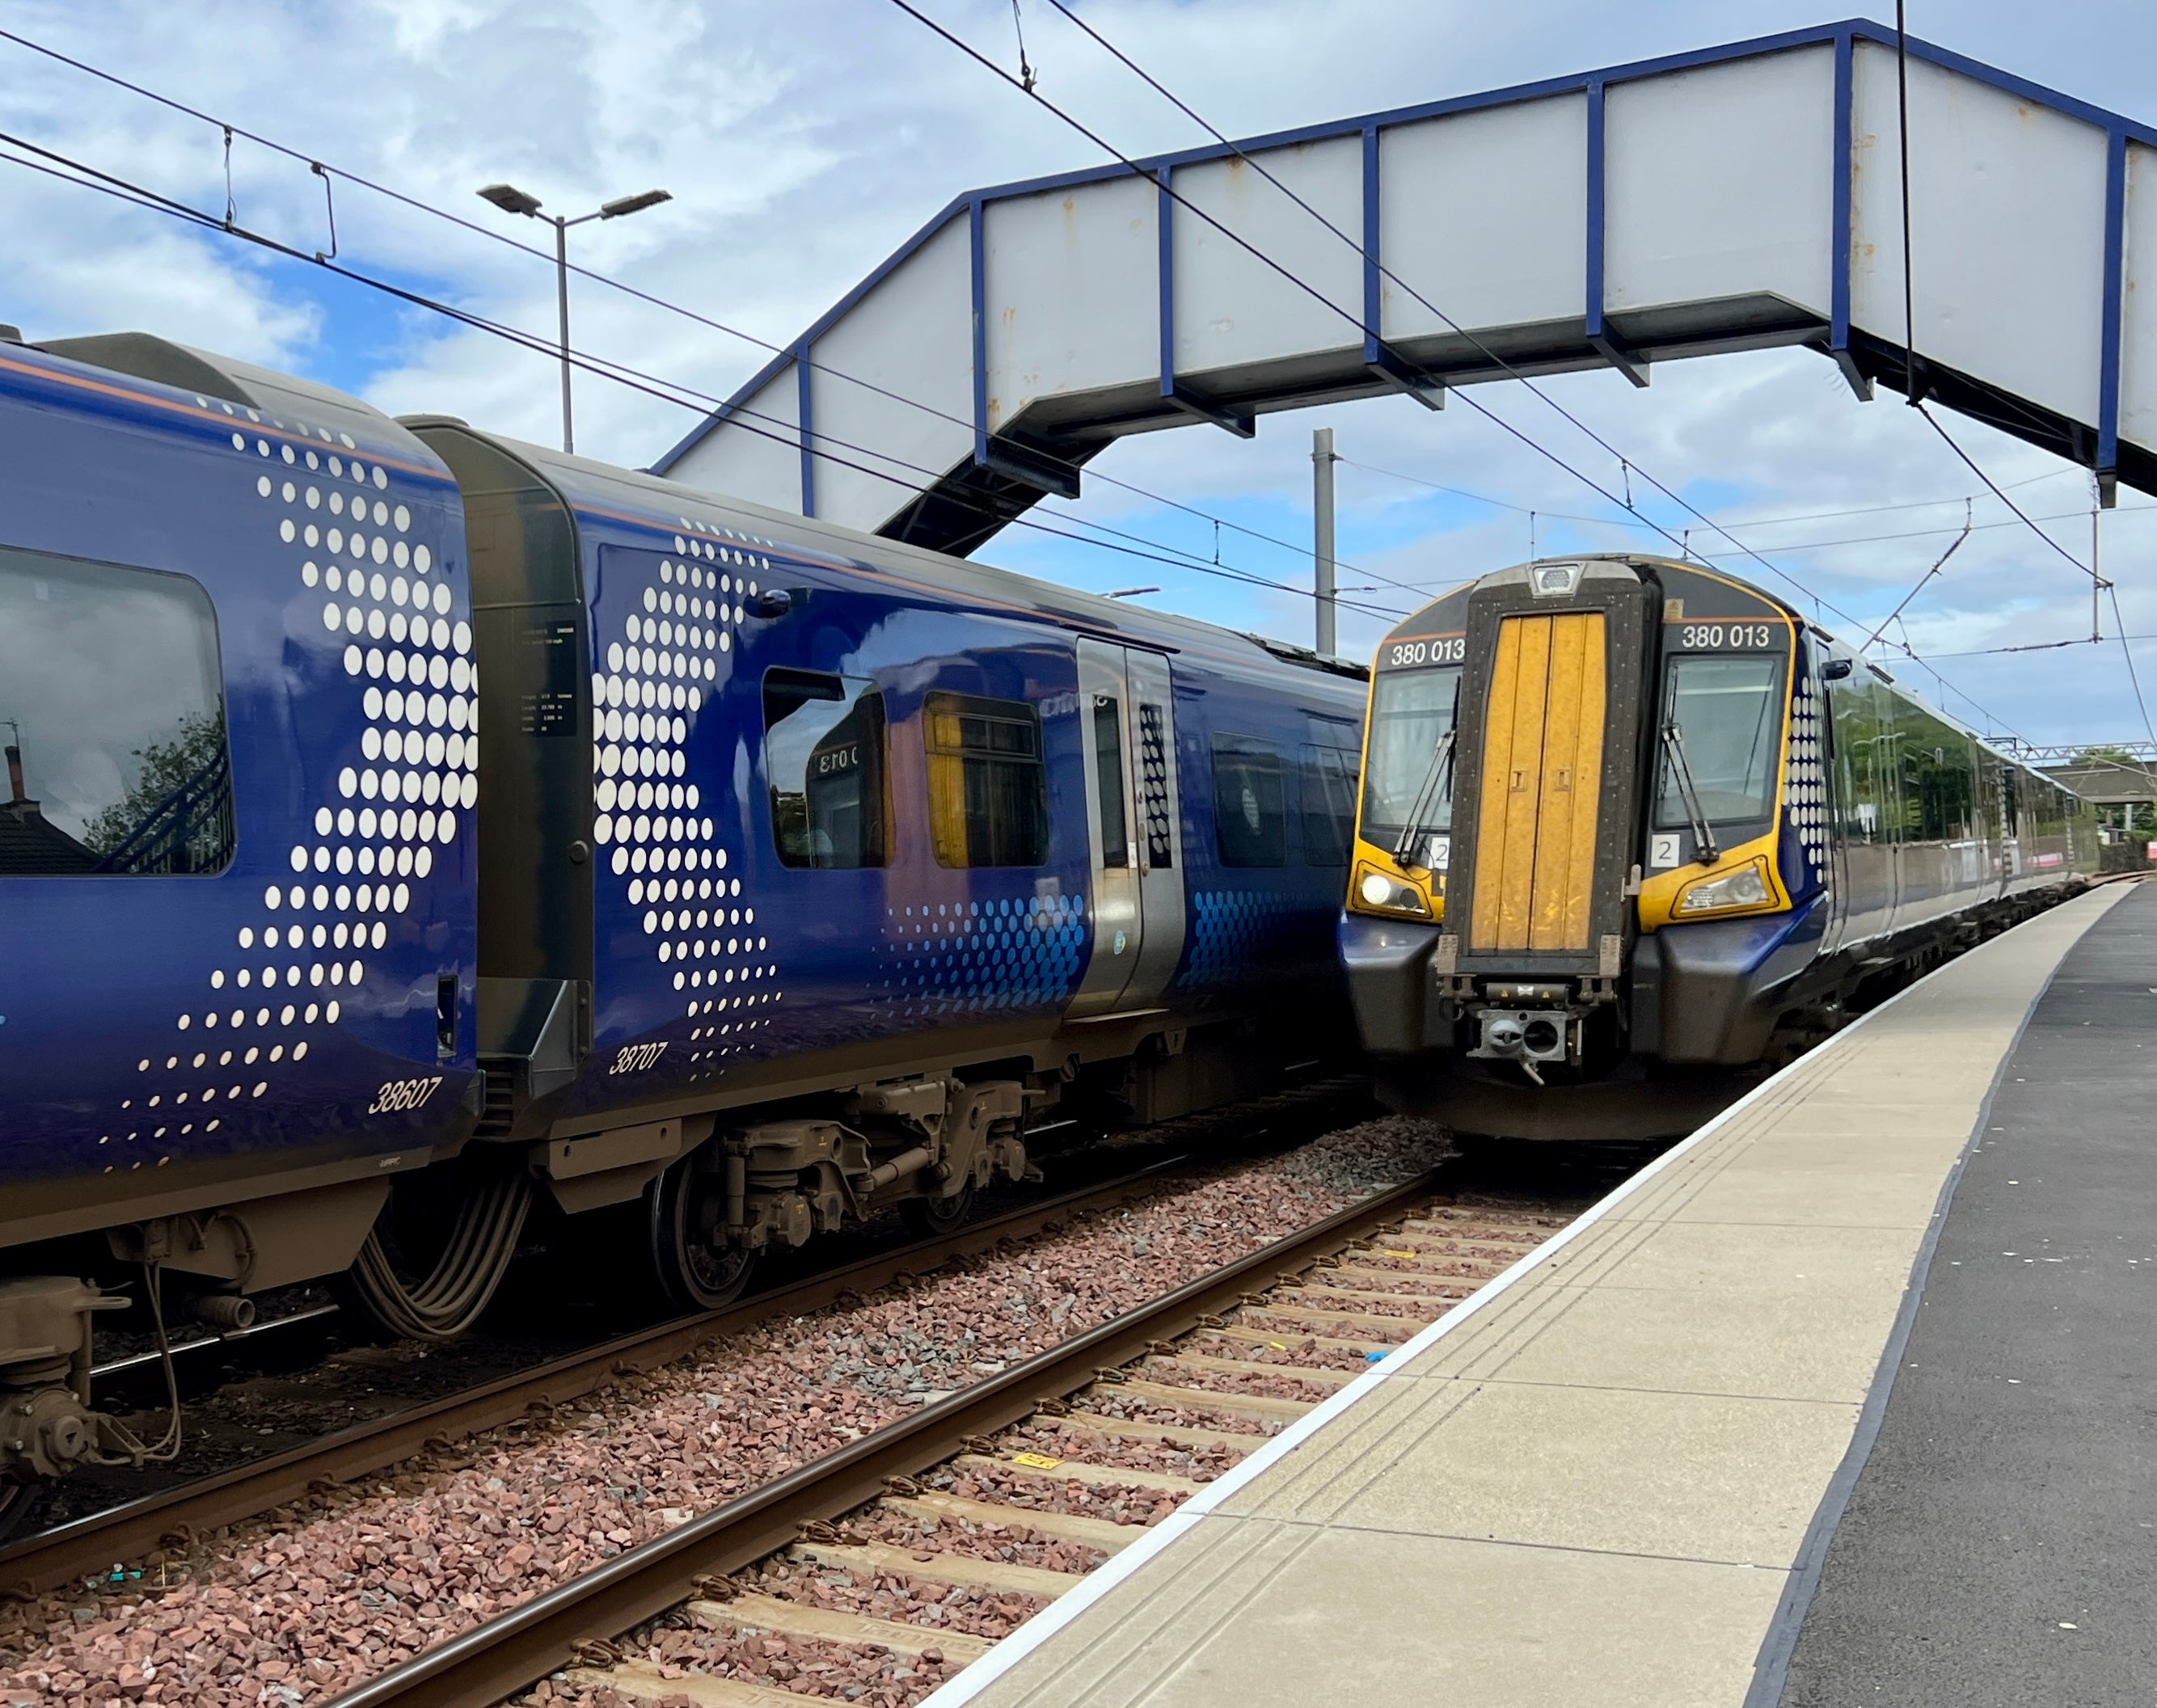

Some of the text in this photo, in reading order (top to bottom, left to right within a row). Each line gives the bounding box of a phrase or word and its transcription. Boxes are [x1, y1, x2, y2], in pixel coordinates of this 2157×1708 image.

[1682, 625, 1770, 647] 380 013
[1391, 639, 1466, 666] 380 013
[1435, 844, 1448, 862] 2
[1659, 841, 1672, 859] 2
[609, 1041, 669, 1075] 38707
[368, 1077, 444, 1115] 38607
